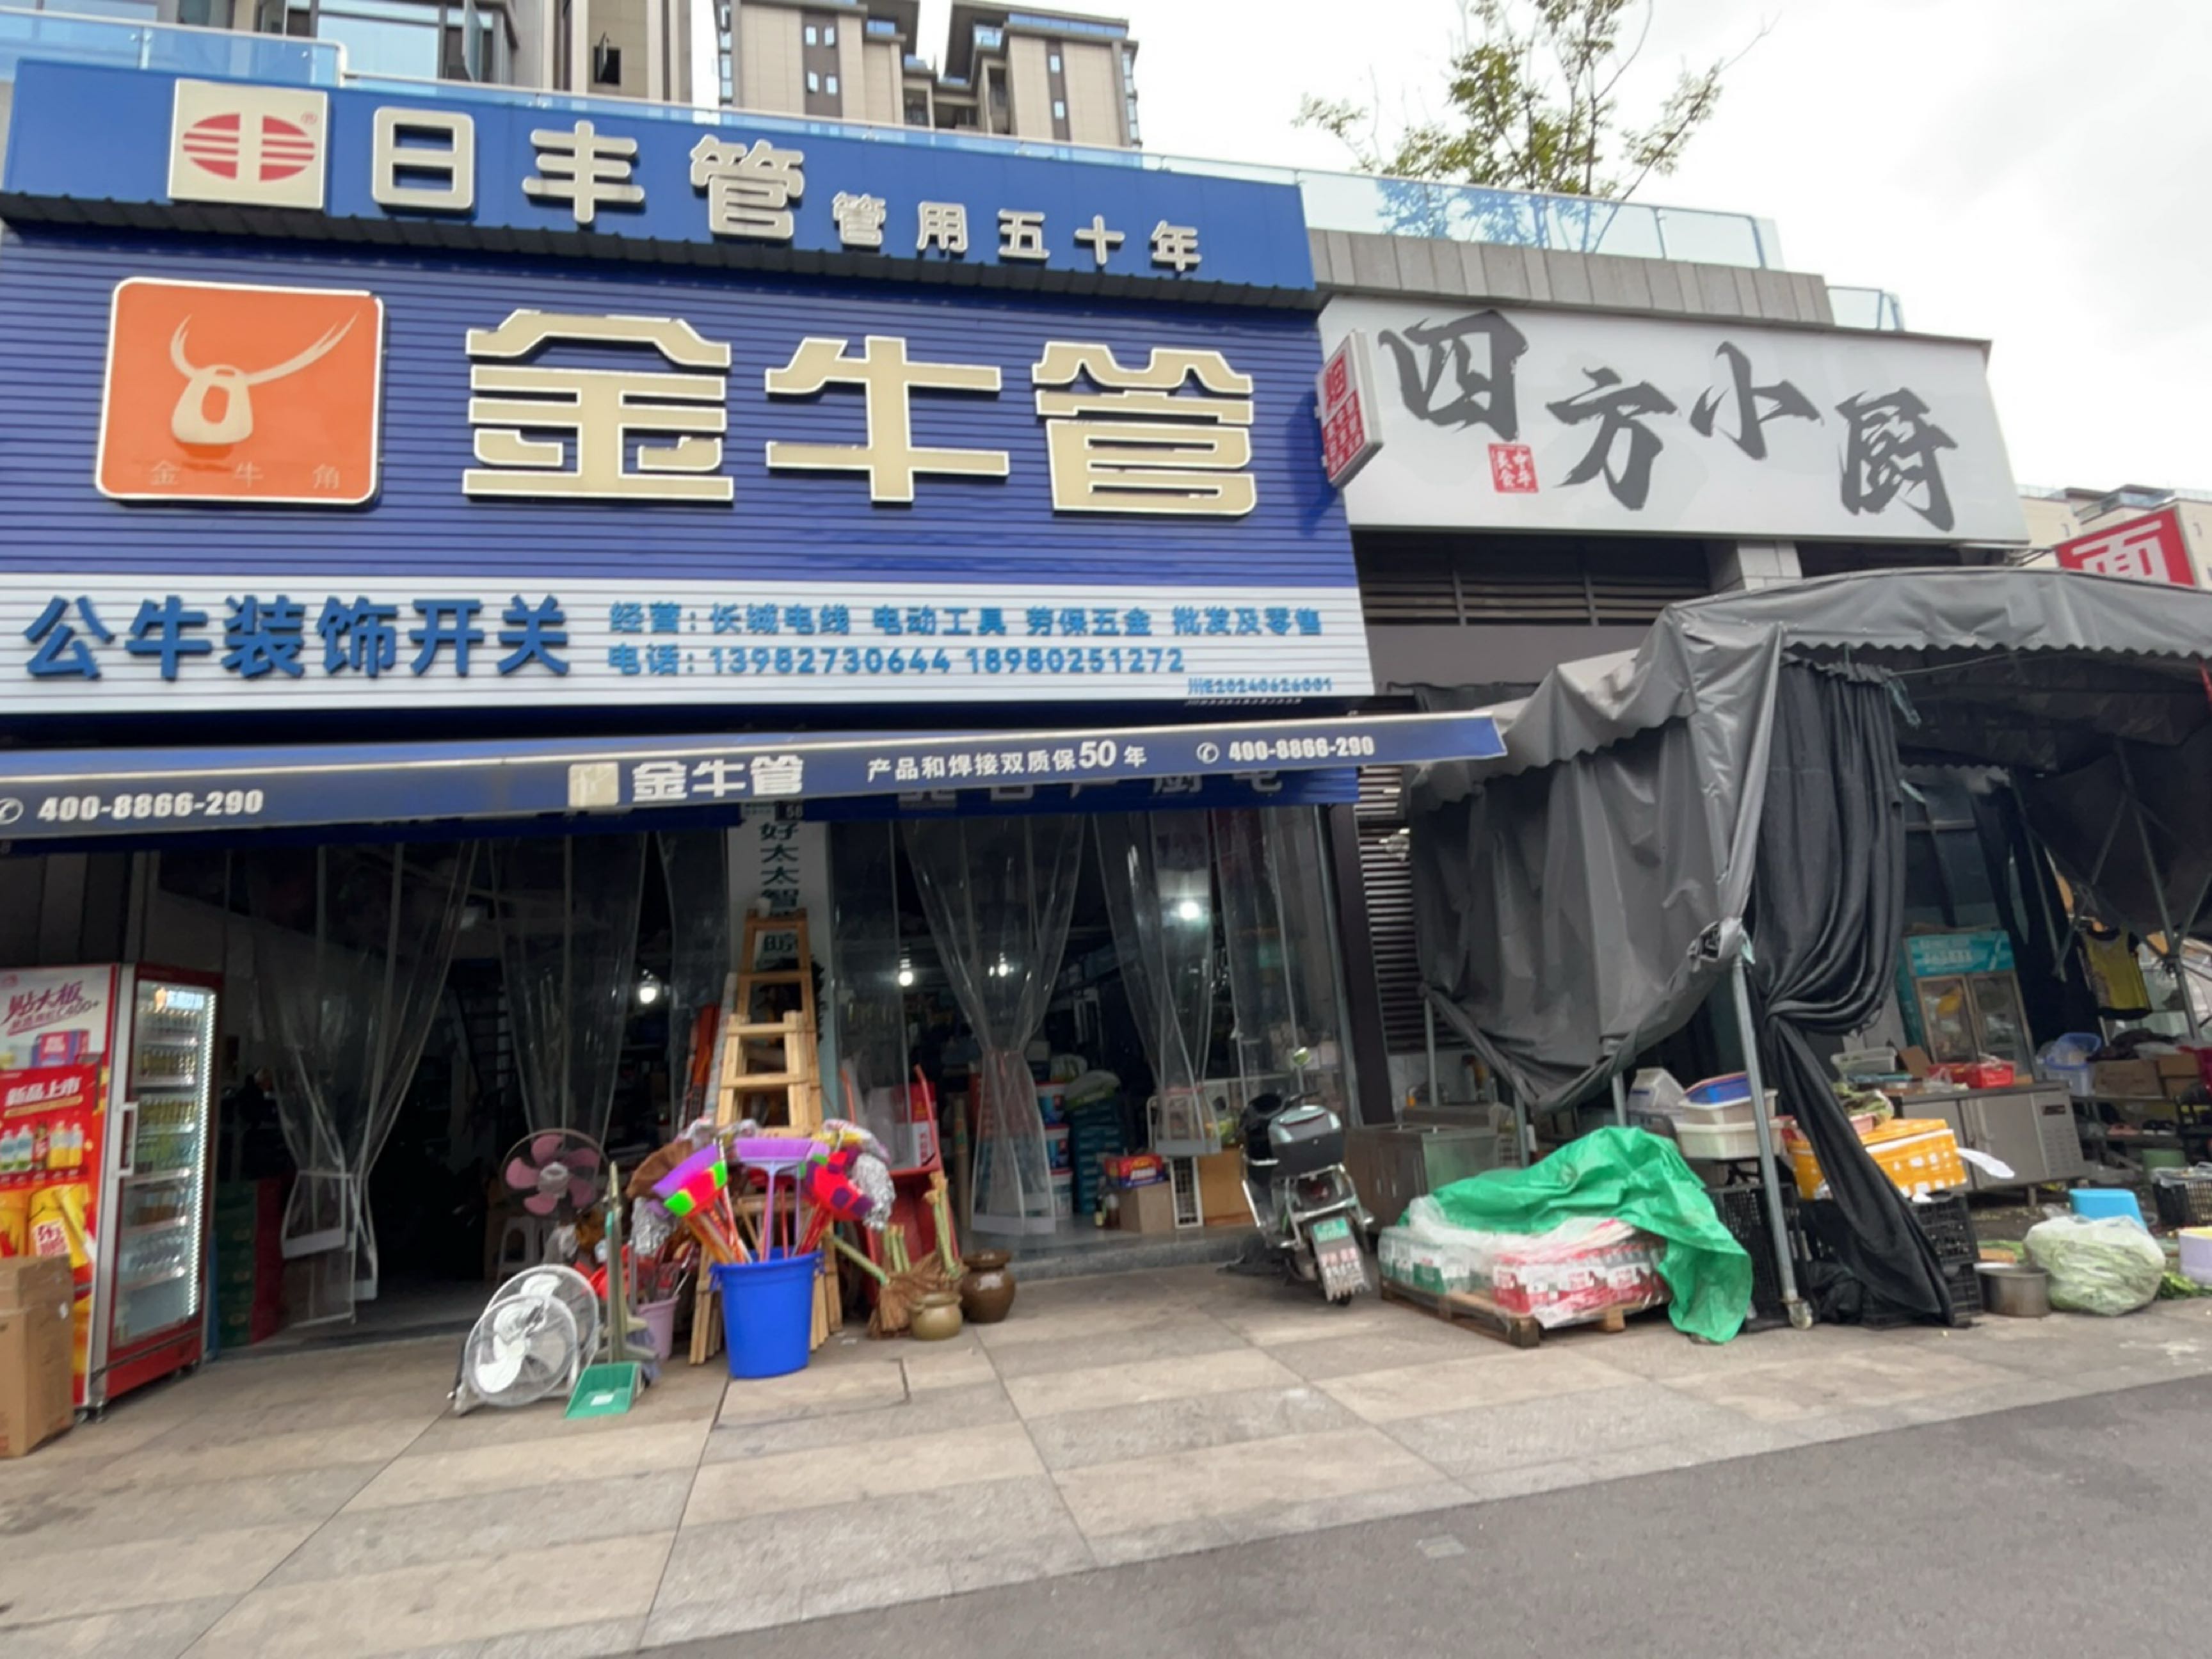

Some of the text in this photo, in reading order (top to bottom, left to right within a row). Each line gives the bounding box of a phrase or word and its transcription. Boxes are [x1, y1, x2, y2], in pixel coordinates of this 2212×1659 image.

[373, 106, 805, 239] 日丰管
[832, 190, 1201, 272] 管用五十年
[462, 309, 1256, 516] 金牛管
[1377, 309, 1959, 532] 四方小厨
[150, 460, 341, 490] 金牛角
[23, 595, 571, 682] 公牛装饰开关
[873, 604, 1007, 636] 电动工具
[1025, 605, 1153, 636] 劳保五金
[1173, 605, 1322, 636] 批发及零售
[966, 648, 1184, 674] 18980251272
[1228, 736, 1375, 762] 400-8866-290
[632, 754, 803, 803] 金牛管
[38, 790, 264, 822] 400-8866-290
[4, 1077, 82, 1107] 新品上市
